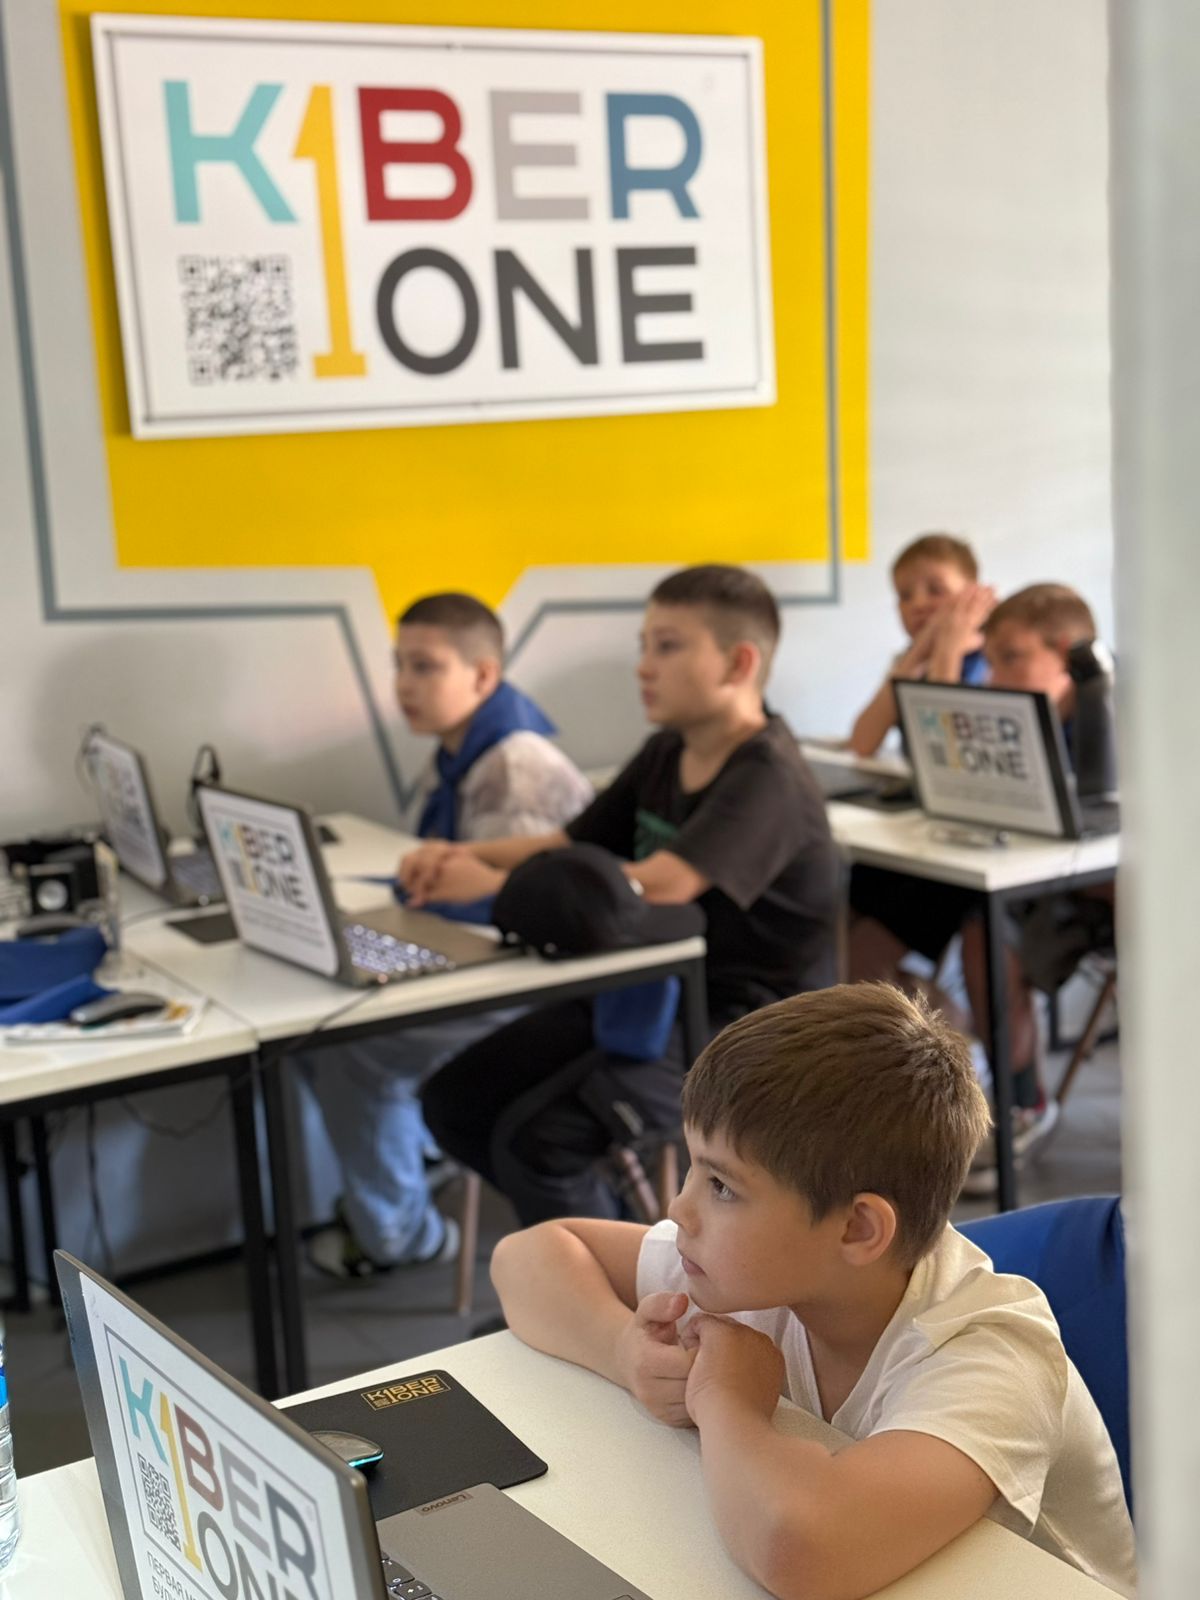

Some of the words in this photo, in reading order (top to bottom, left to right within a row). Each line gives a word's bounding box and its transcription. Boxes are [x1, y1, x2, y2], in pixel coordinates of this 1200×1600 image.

[375, 245, 705, 375] ONE
[961, 745, 1028, 780] ONE
[397, 1384, 444, 1401] ONE
[422, 1494, 466, 1512] Lenovo
